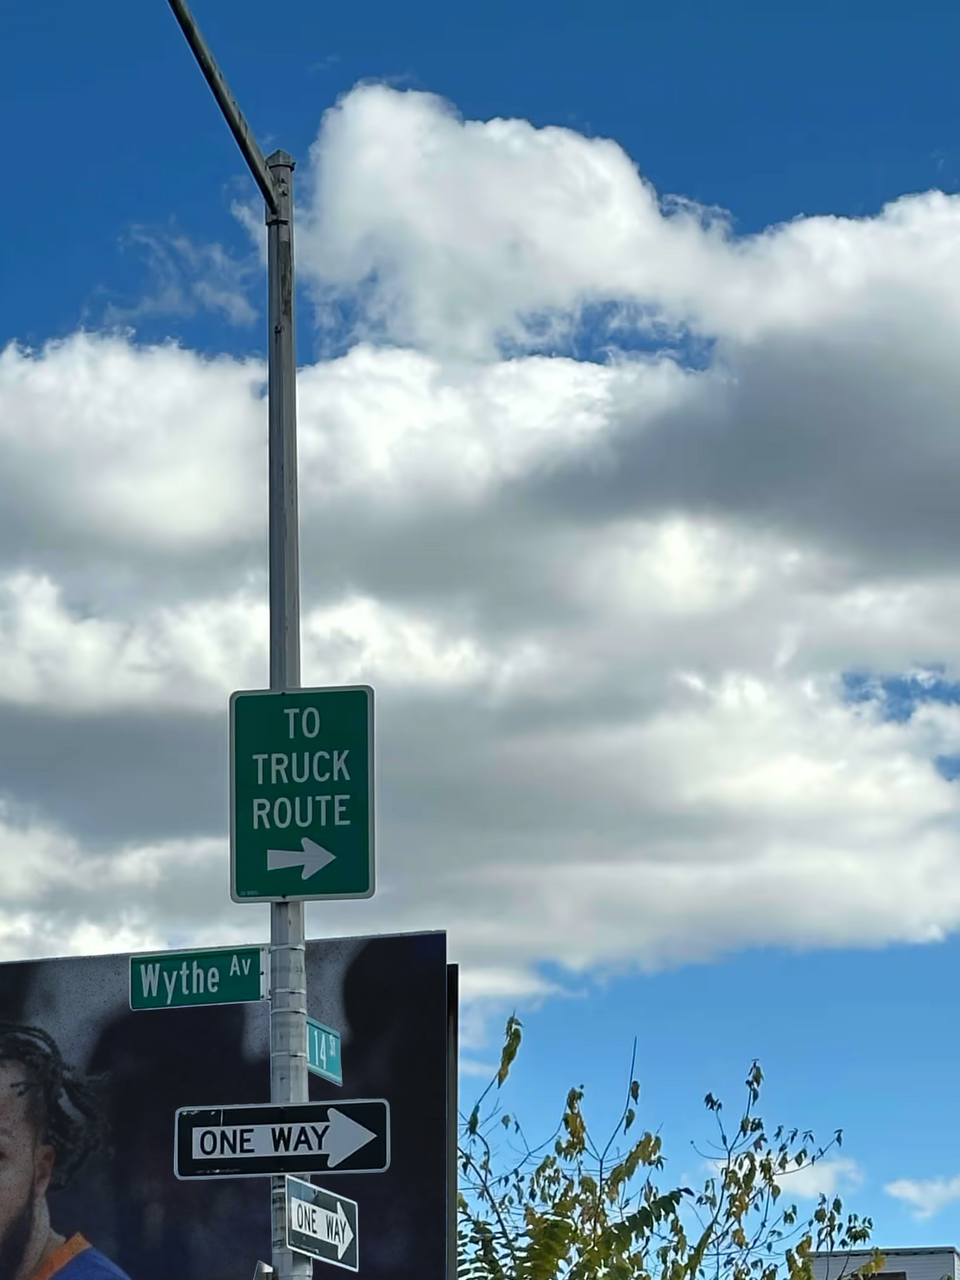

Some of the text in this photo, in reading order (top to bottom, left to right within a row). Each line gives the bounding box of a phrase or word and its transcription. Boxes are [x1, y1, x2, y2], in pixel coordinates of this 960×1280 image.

[284, 707, 321, 739] TO
[252, 749, 351, 785] TRUCK
[252, 794, 351, 830] ROUTE
[140, 955, 251, 1005] Wythe Av
[313, 1030, 327, 1070] 14
[199, 1124, 330, 1156] ONE WAY
[296, 1203, 347, 1245] ONE WAY
